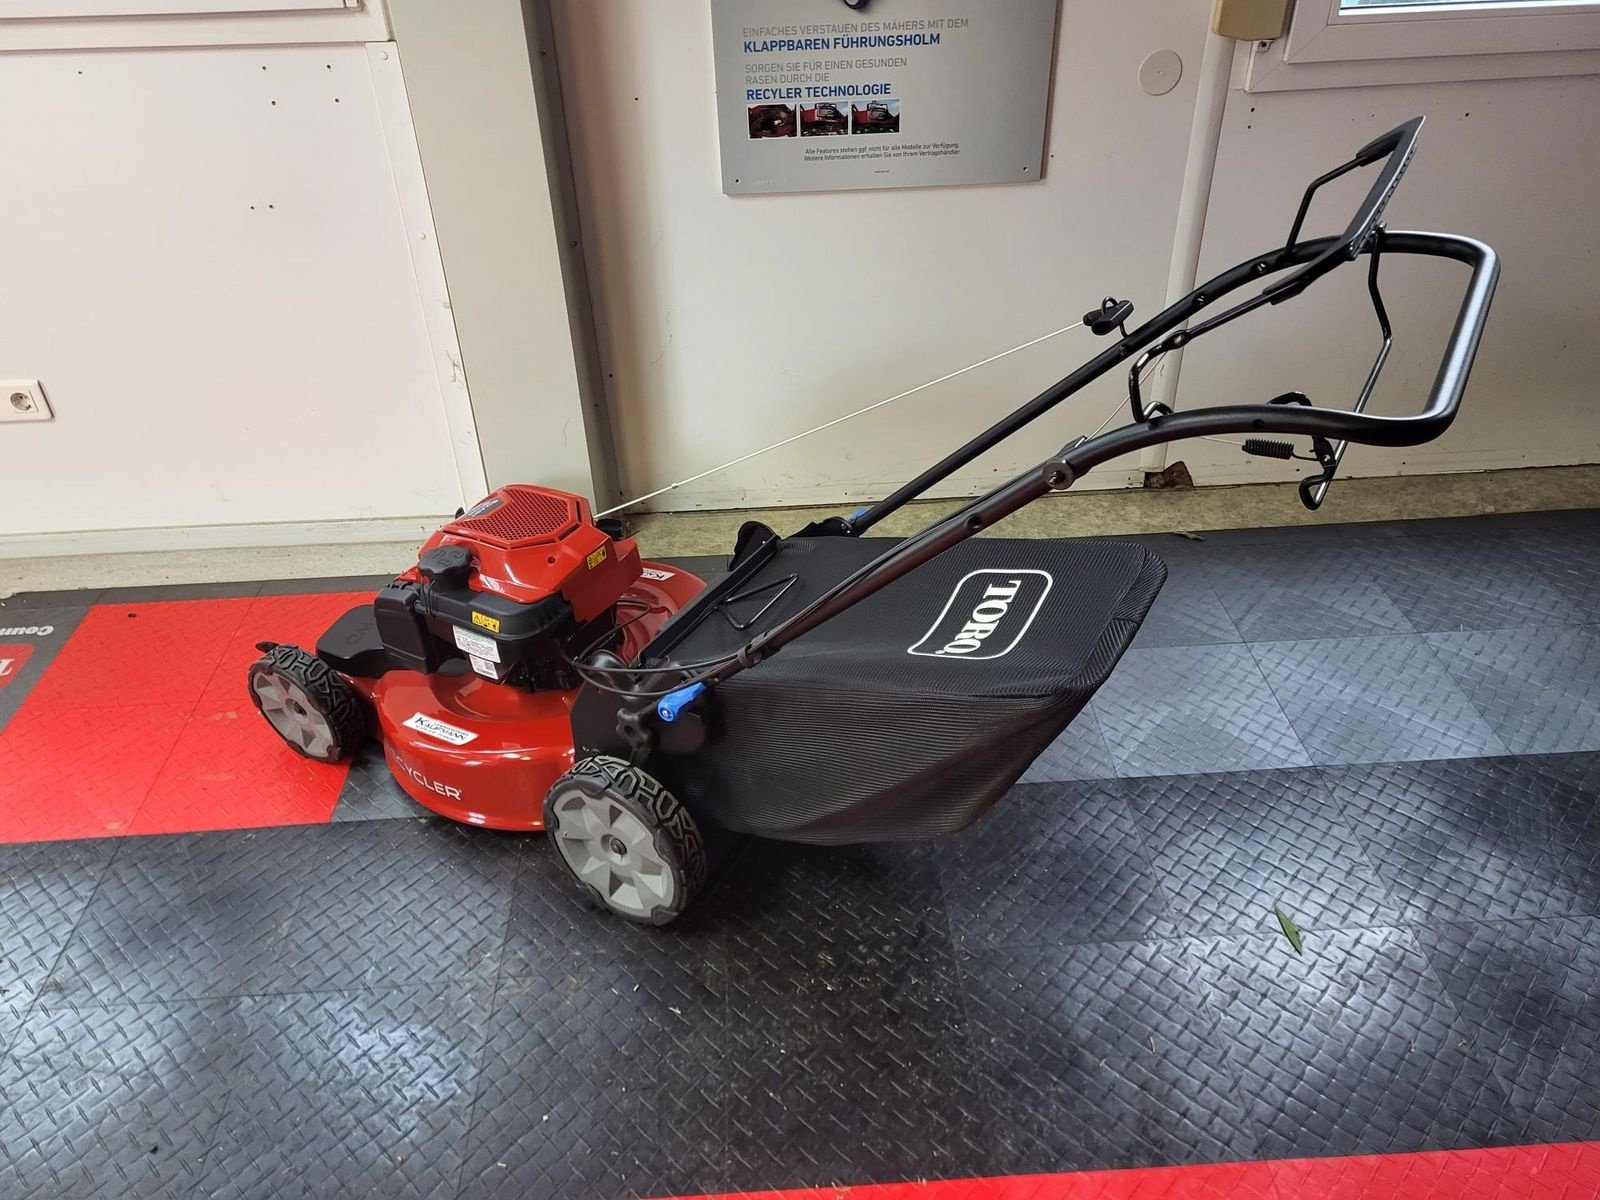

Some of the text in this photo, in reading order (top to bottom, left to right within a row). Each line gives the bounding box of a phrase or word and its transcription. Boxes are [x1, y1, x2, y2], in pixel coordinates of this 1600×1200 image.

[743, 18, 969, 37] EINFACHES VERSTAUEN DES MÄHERS MIT DEM
[743, 32, 941, 53] KLAPPBAREN FÜHRUNGSHOLM
[744, 57, 908, 74] SORGEN SIE FÜR EINEN GESUNDEN
[745, 72, 830, 85] RASEN DURCH DIE
[746, 83, 892, 100] RECYLER TECHNOLOGIE
[389, 749, 462, 801] CYCLER
